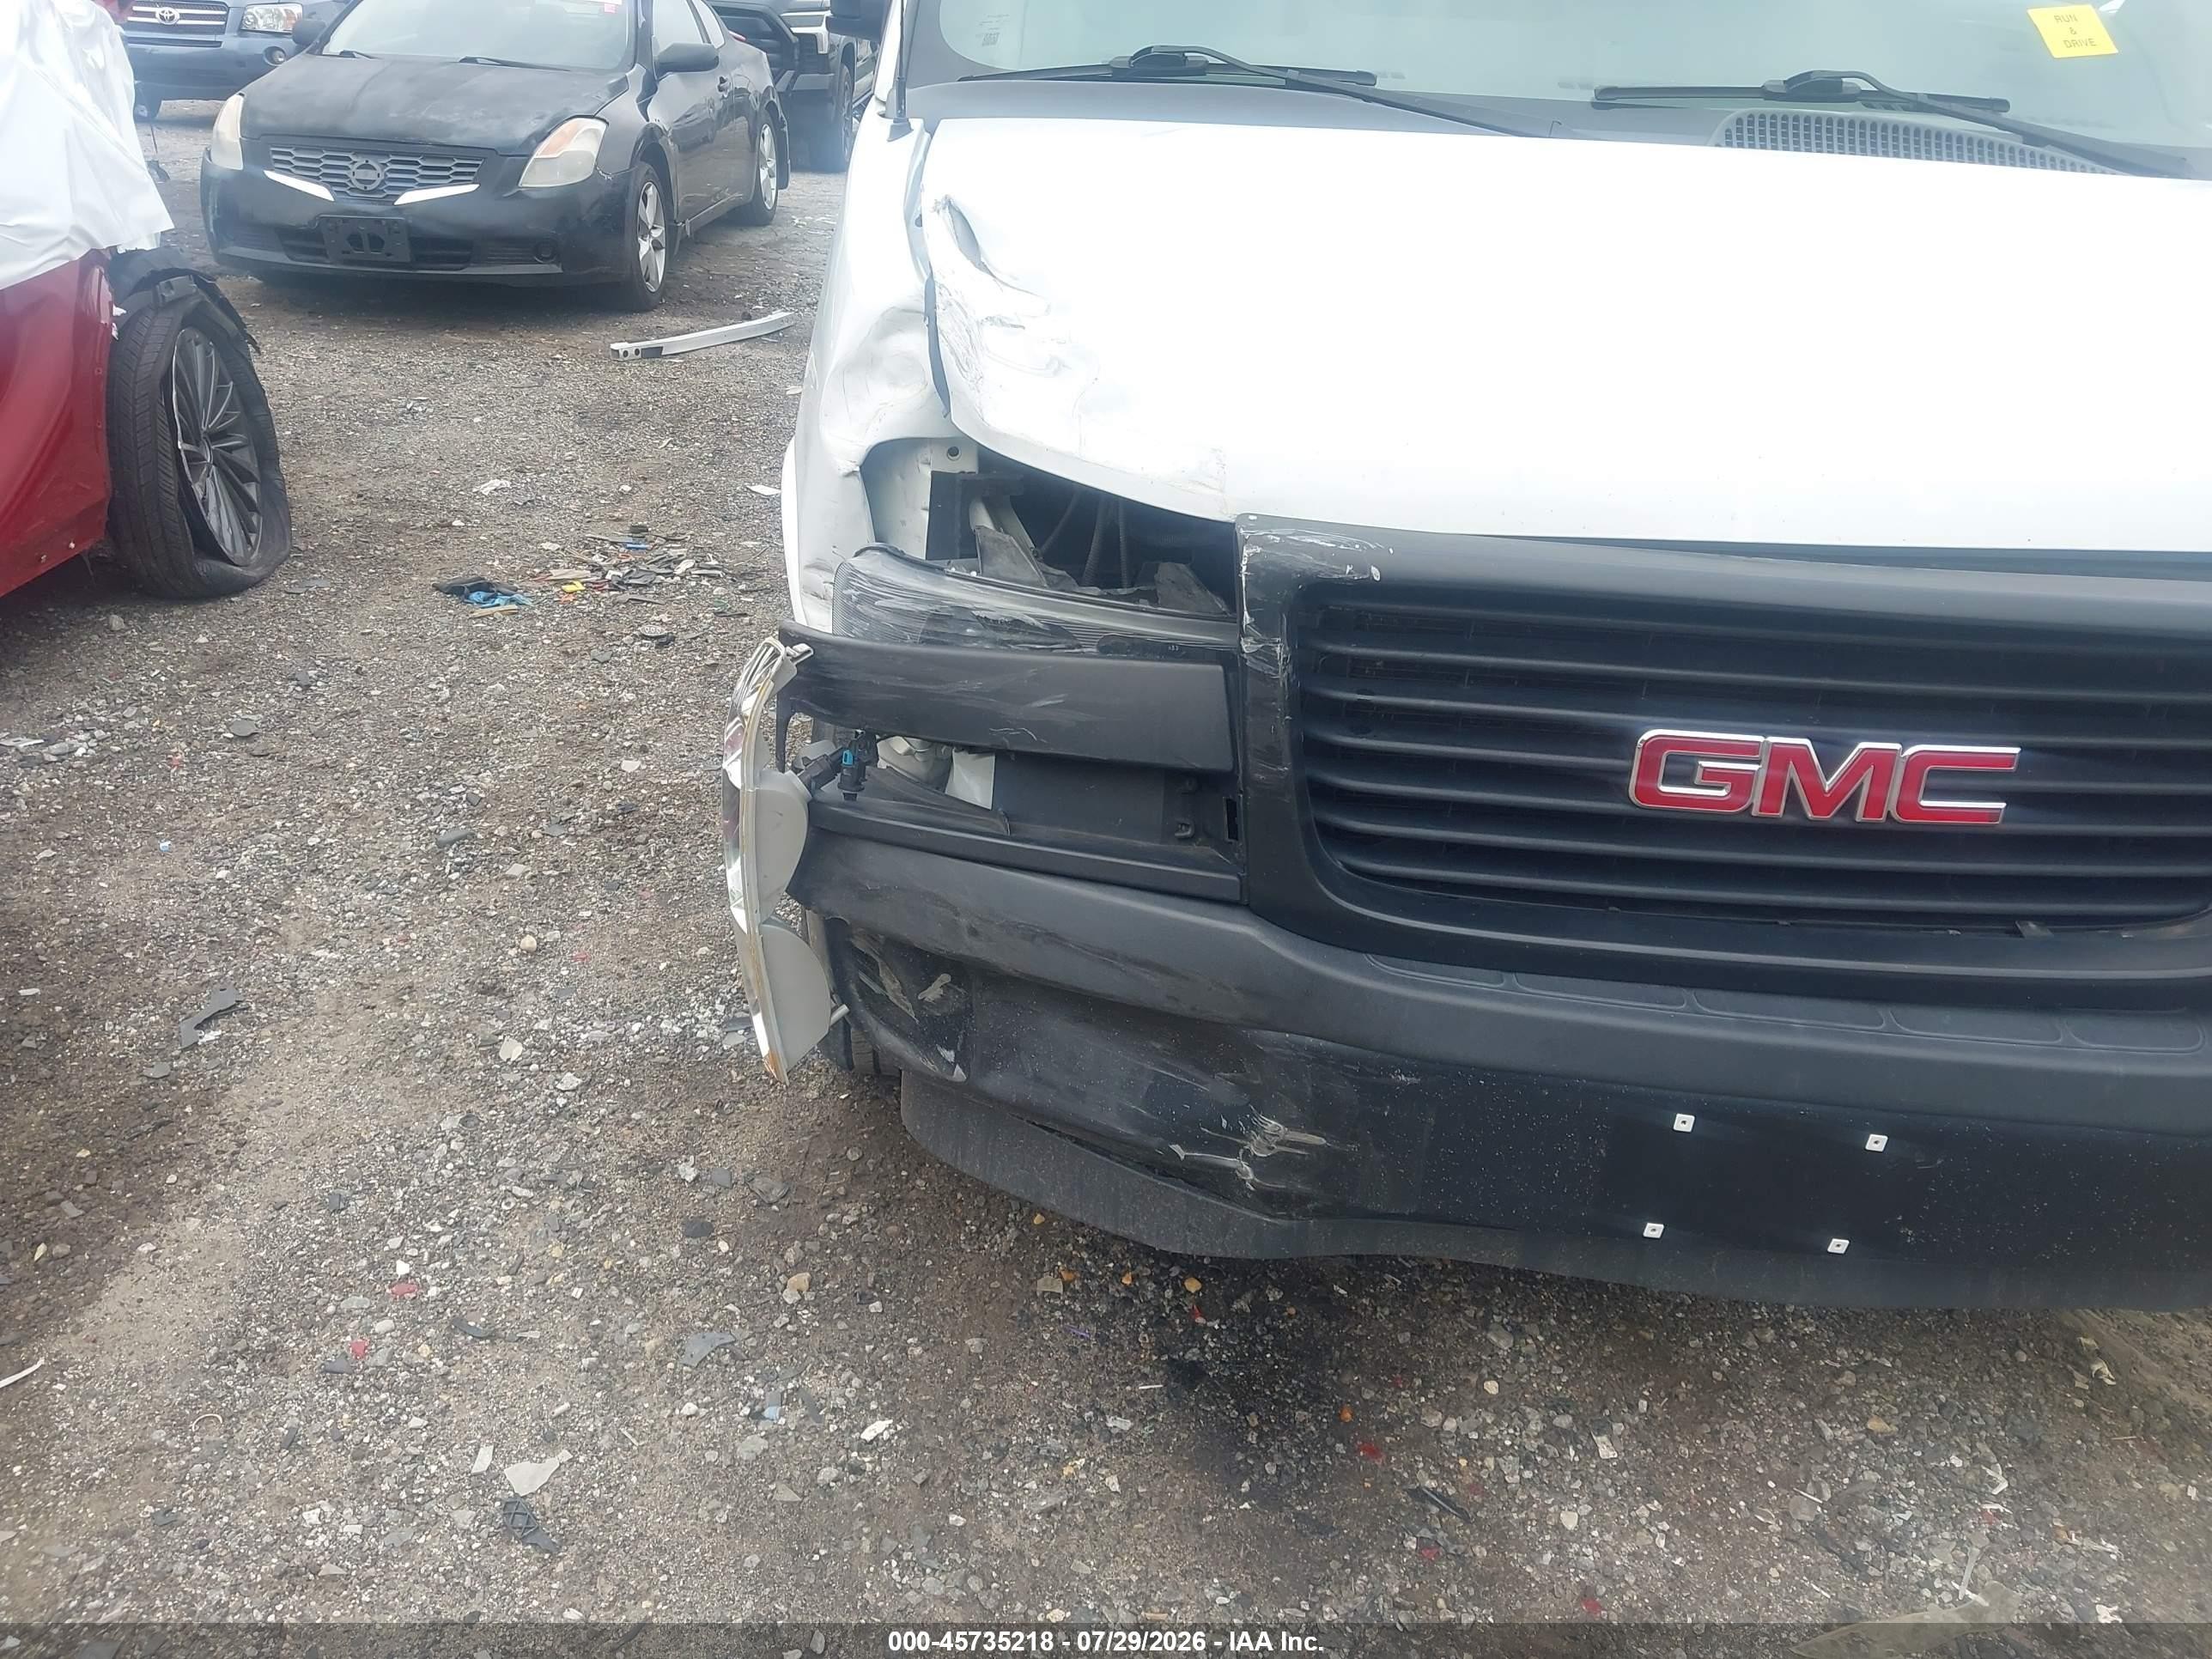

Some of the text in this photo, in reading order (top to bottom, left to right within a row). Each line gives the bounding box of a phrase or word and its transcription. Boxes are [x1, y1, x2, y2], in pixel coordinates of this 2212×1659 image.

[2054, 14, 2078, 22] RUN
[2069, 27, 2077, 35] &
[2063, 38, 2097, 48] DRIVE
[1628, 729, 2021, 824] GMC
